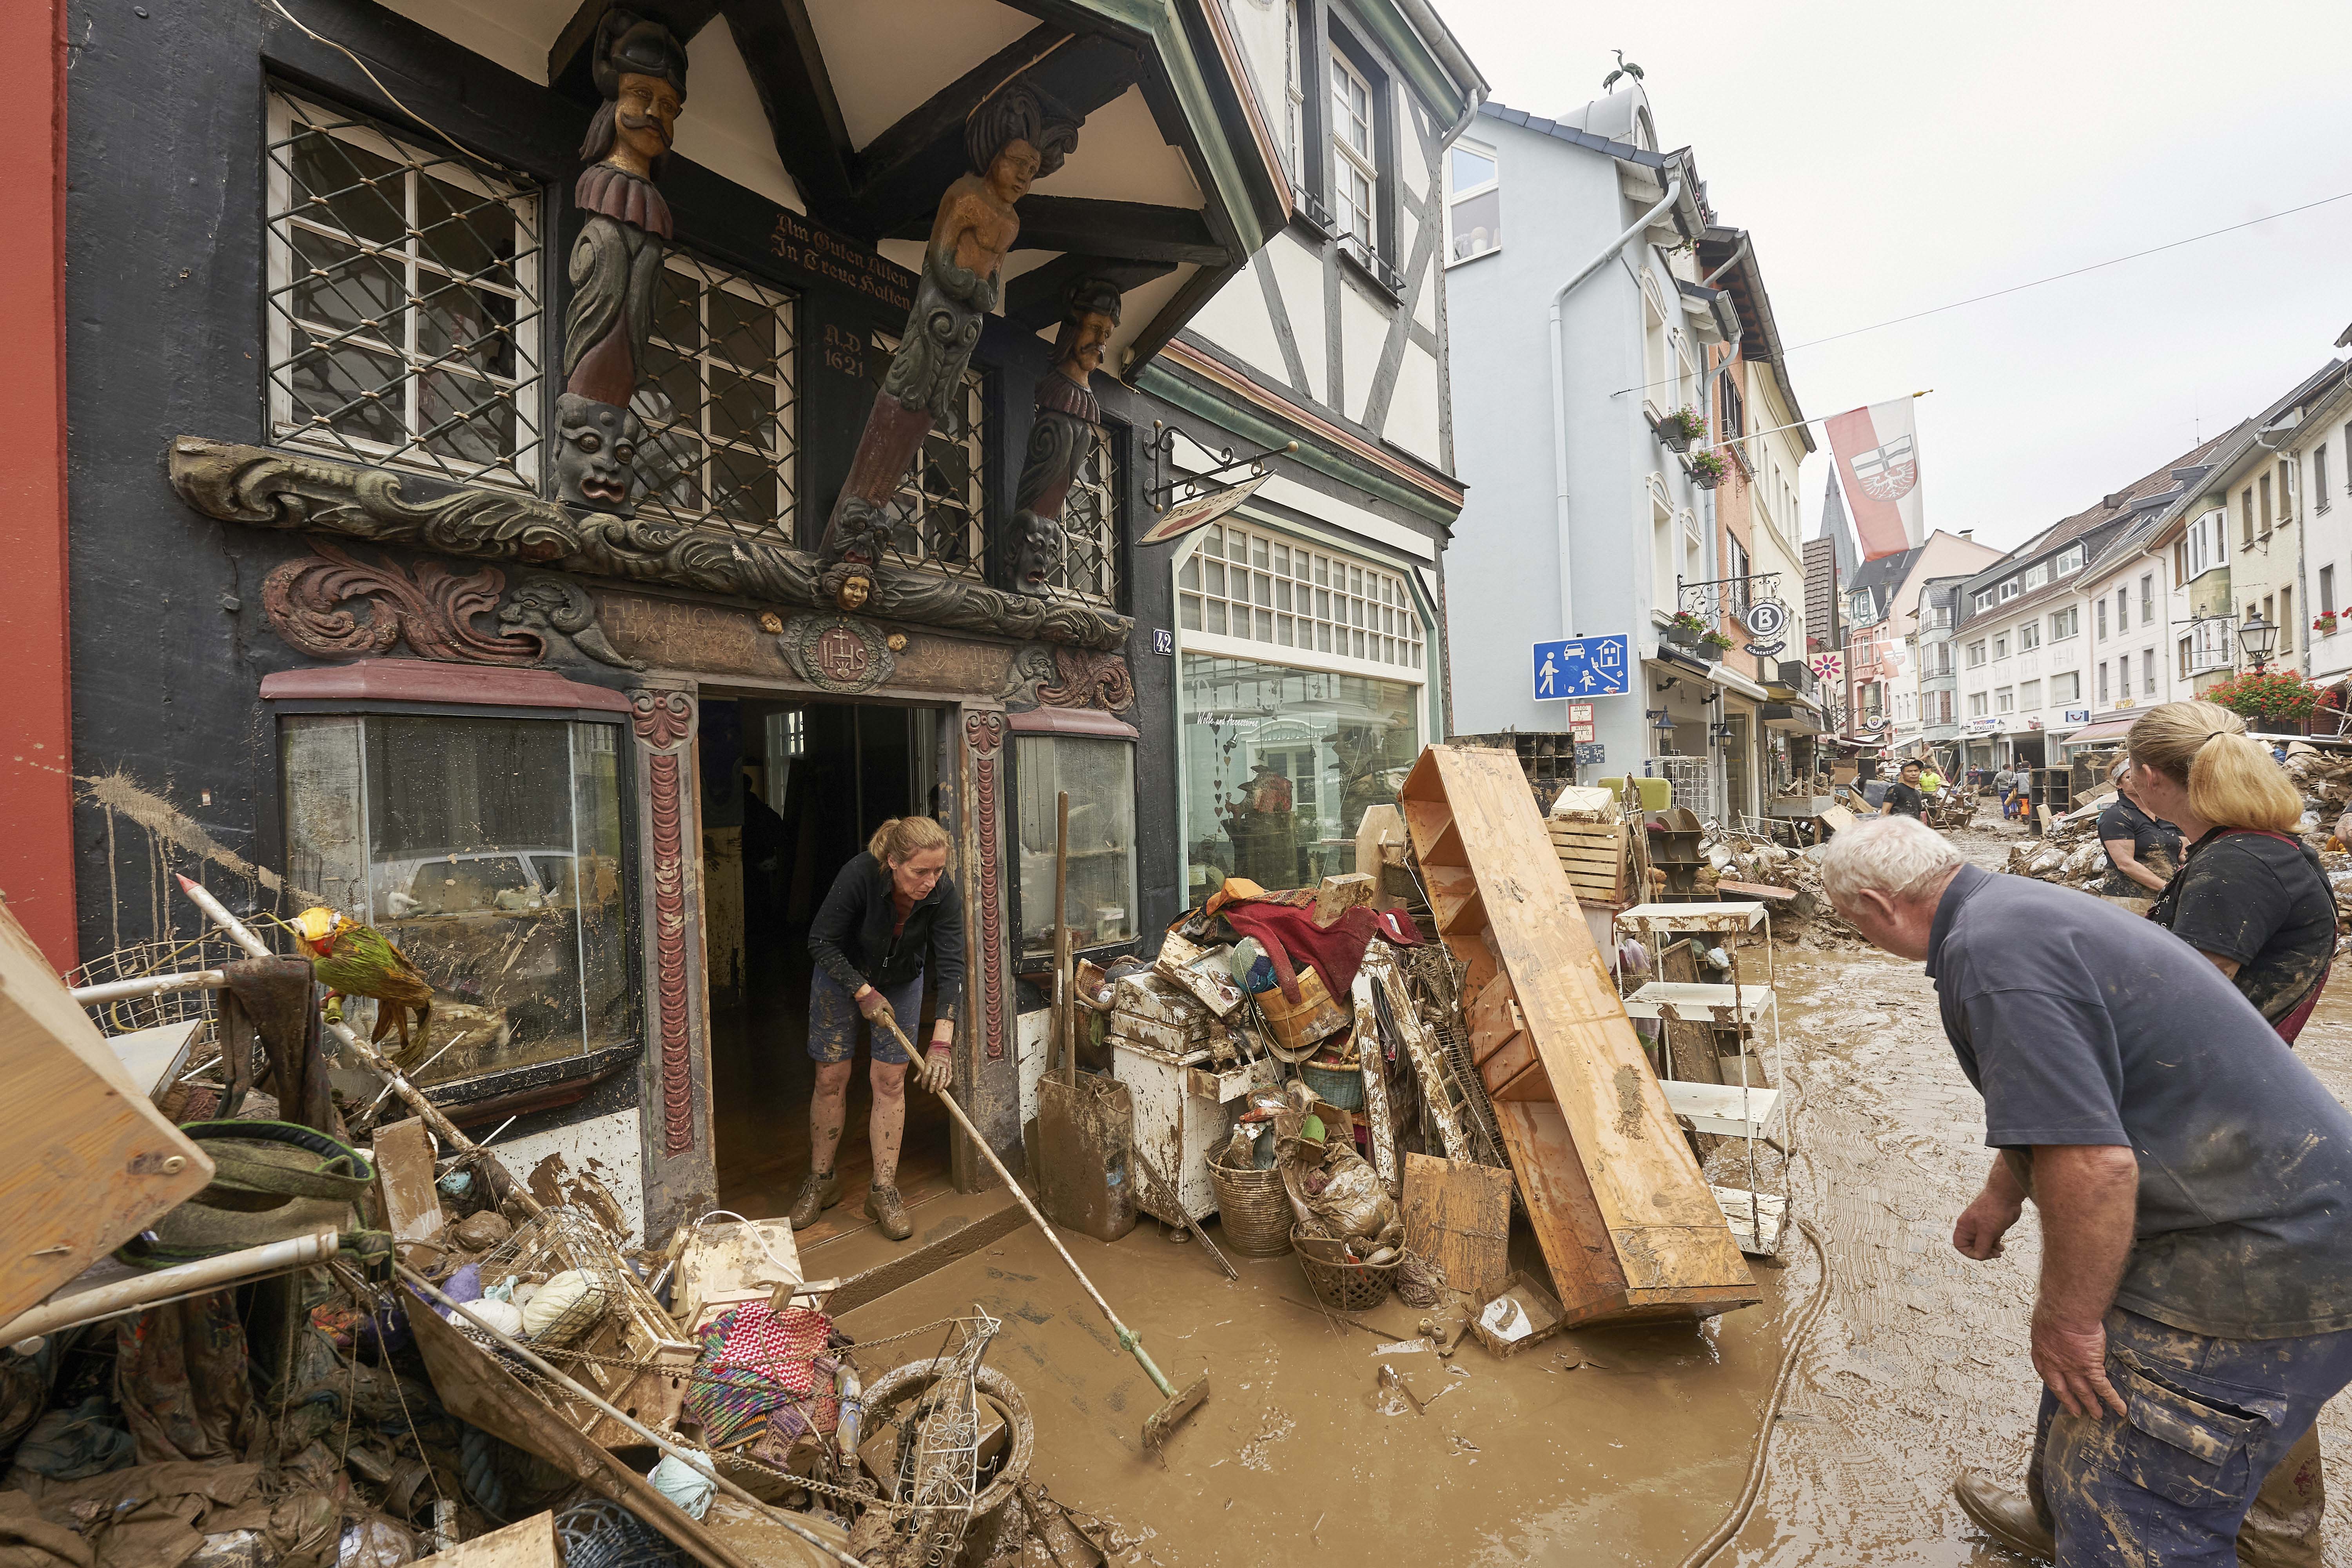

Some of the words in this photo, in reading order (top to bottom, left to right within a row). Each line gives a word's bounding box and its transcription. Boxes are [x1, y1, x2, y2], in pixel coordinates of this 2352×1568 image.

[776, 214, 809, 242] Am
[813, 231, 864, 269] Guten
[771, 234, 798, 262] In
[804, 249, 856, 287] Treue
[859, 275, 910, 311] Halten
[1759, 609, 1773, 628] B
[1157, 632, 1171, 653] 42
[1747, 644, 1783, 655] Schatztruhe
[822, 640, 865, 670] IHS
[1197, 711, 1214, 725] Wolle
[1227, 713, 1258, 727] Accessoires
